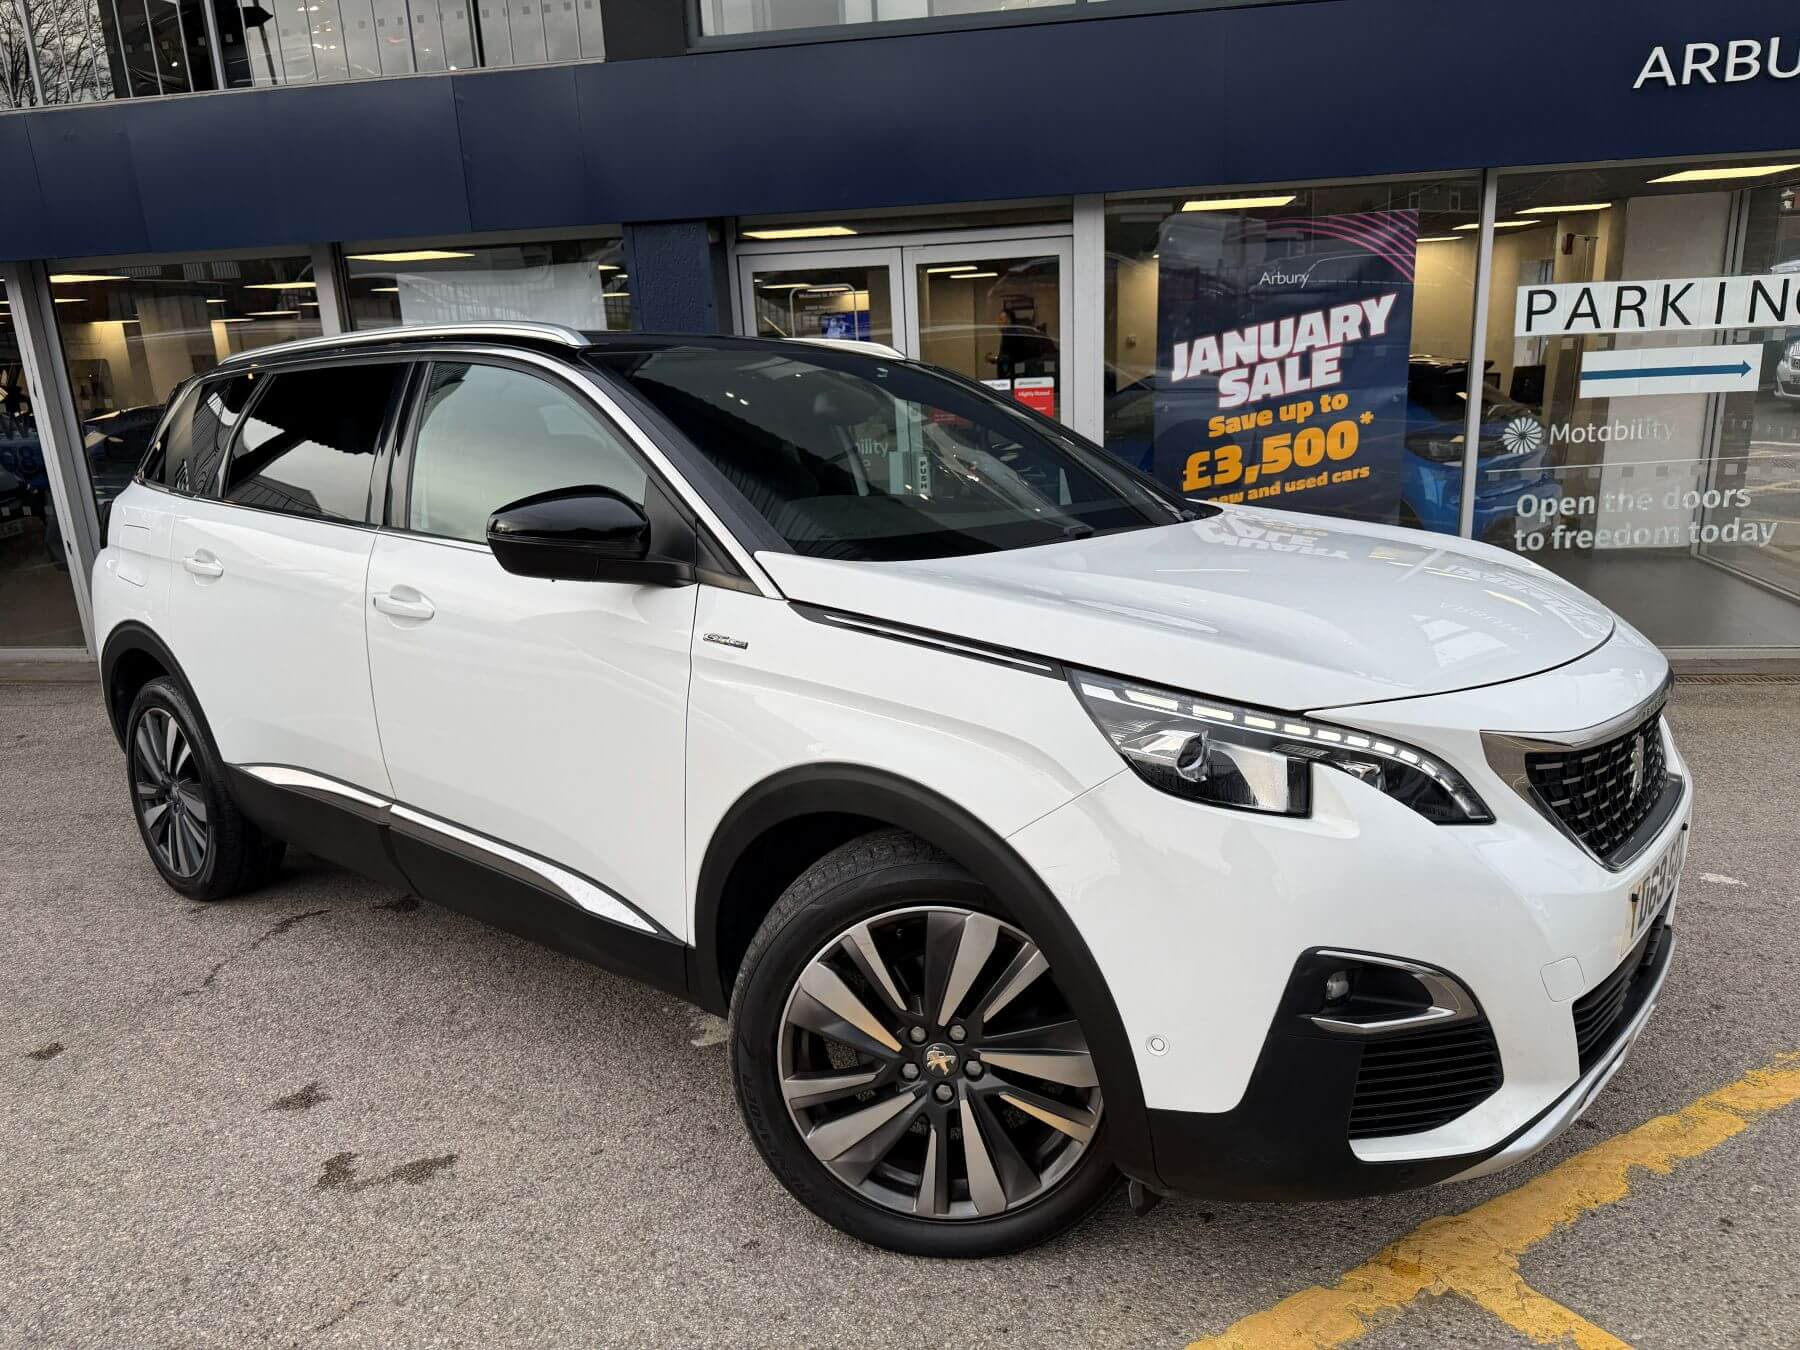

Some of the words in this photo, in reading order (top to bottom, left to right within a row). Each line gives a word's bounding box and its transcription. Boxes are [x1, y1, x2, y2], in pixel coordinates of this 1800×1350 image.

[1259, 271, 1309, 288] Arbury
[1525, 278, 1800, 332] PARKIN
[1171, 293, 1397, 382] JANUARY
[1218, 346, 1341, 408] SALE
[1208, 414, 1272, 438] Save
[1279, 403, 1313, 424] up
[1320, 392, 1348, 413] to
[1549, 415, 1678, 445] Motability
[920, 460, 928, 490] PUSH
[1248, 482, 1281, 500] and
[1285, 475, 1329, 492] used
[1332, 466, 1370, 483] cars
[1516, 493, 1596, 522] Open
[1602, 486, 1652, 511] the
[1663, 485, 1752, 511] doors
[1514, 530, 1545, 551] to
[1551, 523, 1680, 549] freedom
[1688, 517, 1778, 547] today
